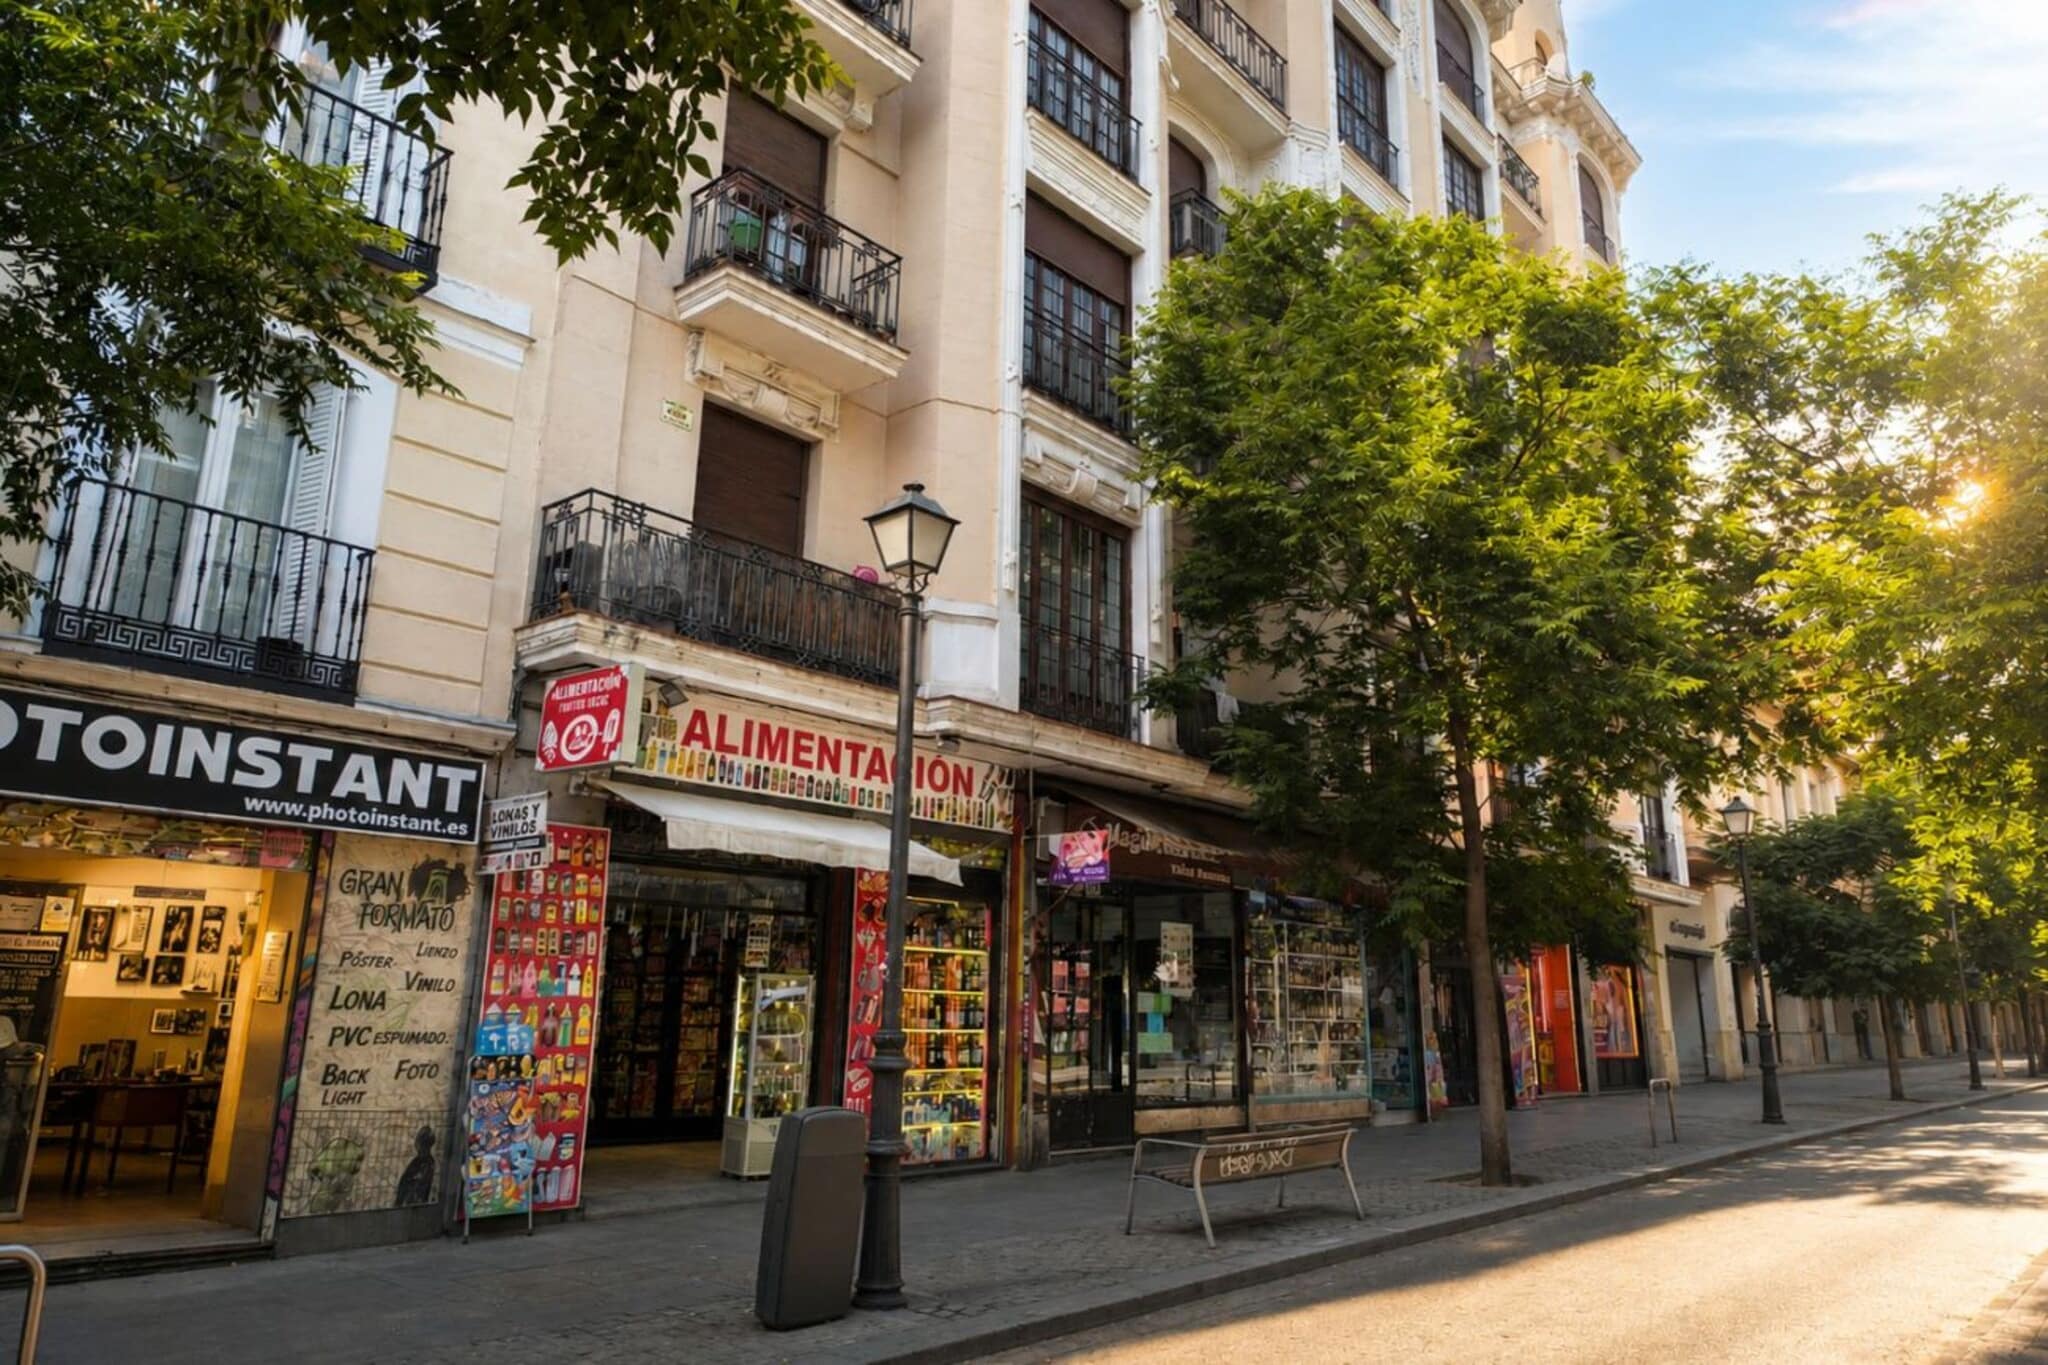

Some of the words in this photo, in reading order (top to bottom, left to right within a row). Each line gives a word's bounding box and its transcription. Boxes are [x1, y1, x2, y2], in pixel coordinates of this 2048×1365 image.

[0, 699, 477, 813] TOINSTANT
[681, 709, 974, 798] ALIMENTAIÓN
[244, 797, 469, 836] www.photoinstant.es
[532, 803, 541, 818] Y
[338, 869, 404, 900] GRAN
[359, 902, 455, 933] FORMATO
[416, 941, 458, 960] LIENZO
[405, 970, 456, 993] VINILO
[328, 985, 386, 1011] LONA
[328, 1026, 371, 1048] PVC
[321, 1063, 369, 1087] BACK
[394, 1059, 440, 1081] FOTO
[321, 1089, 367, 1107] LIGHT
